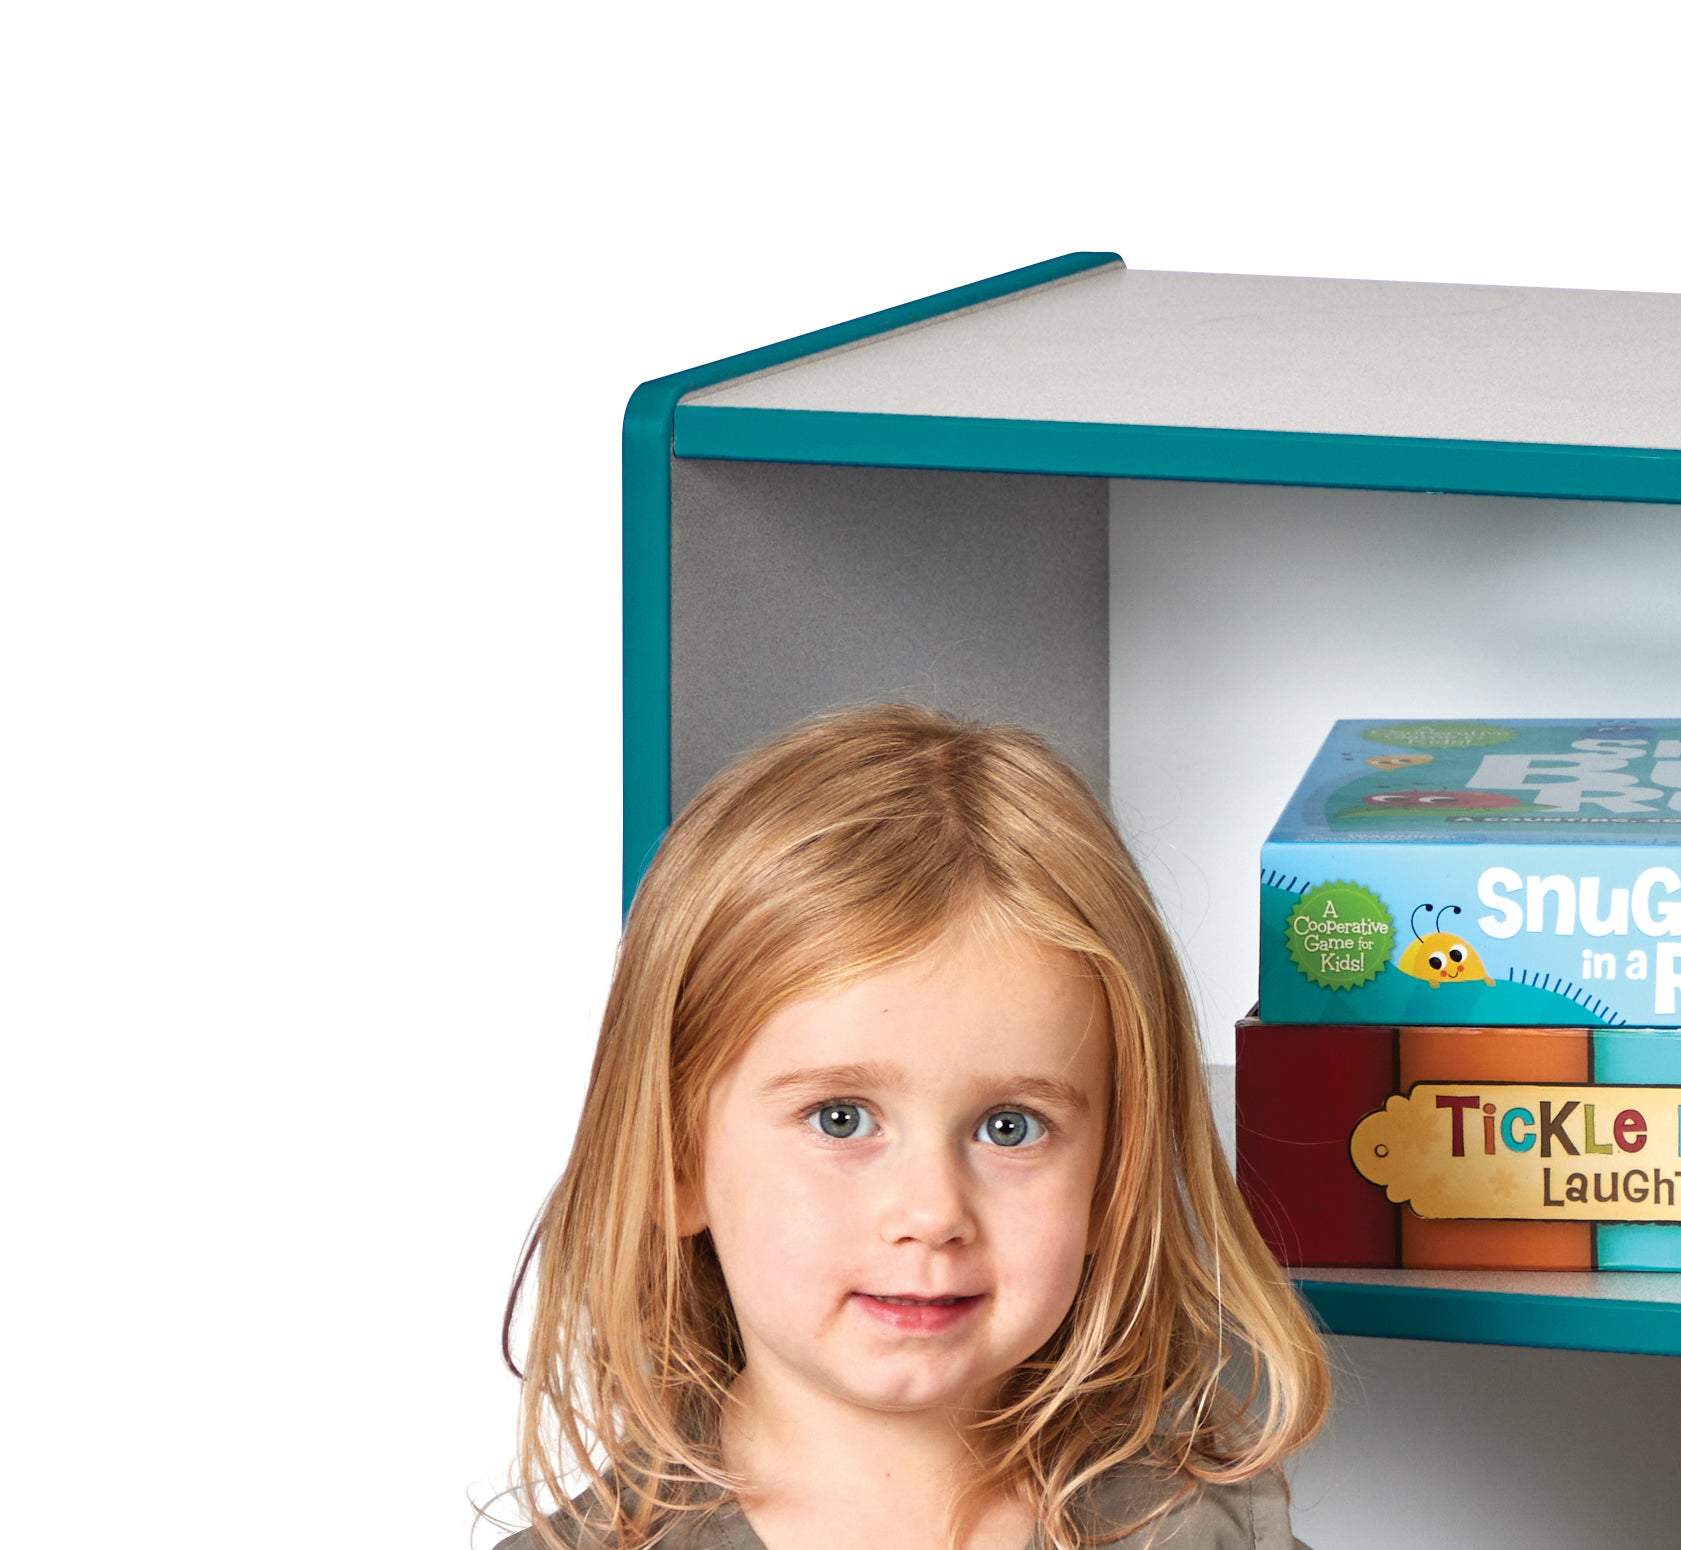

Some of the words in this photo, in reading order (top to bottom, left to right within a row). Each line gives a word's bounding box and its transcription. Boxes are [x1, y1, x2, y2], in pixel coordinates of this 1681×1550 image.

[1322, 900, 1338, 918] A
[1294, 915, 1389, 936] Cooperative
[1304, 934, 1354, 952] Game
[1358, 937, 1374, 950] for
[1321, 952, 1365, 972] Kids!
[1581, 949, 1616, 981] in
[1625, 949, 1648, 981] a
